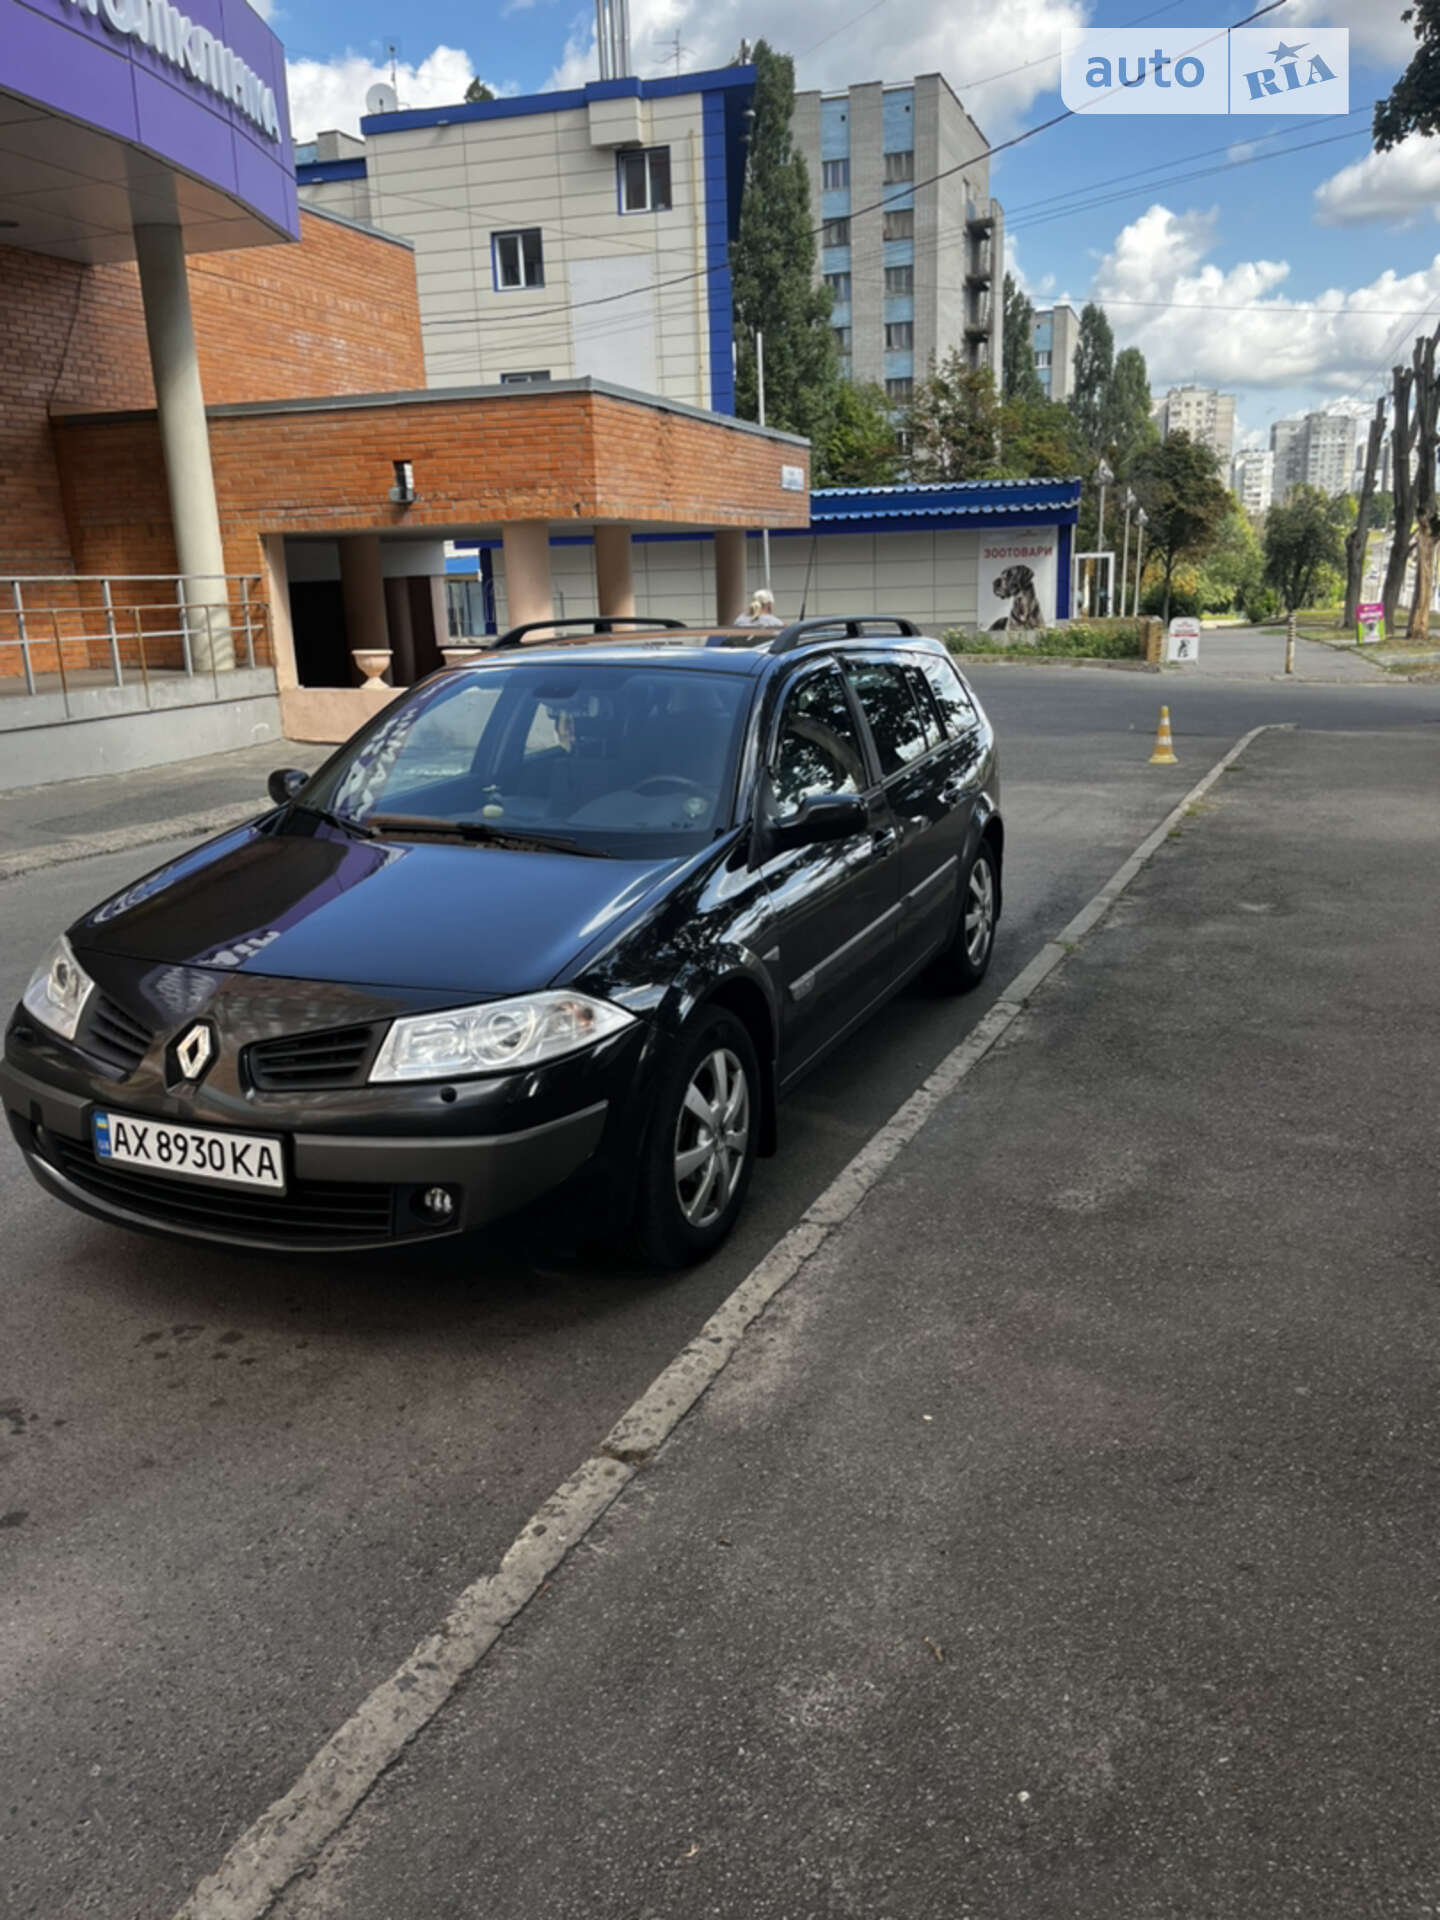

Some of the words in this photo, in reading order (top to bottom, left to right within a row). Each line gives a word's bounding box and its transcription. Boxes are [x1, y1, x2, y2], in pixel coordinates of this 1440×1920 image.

[984, 546, 1053, 559] ЗООТОВАРИ
[114, 1122, 151, 1159] AX
[156, 1130, 226, 1172] 8930
[230, 1141, 278, 1180] KA
